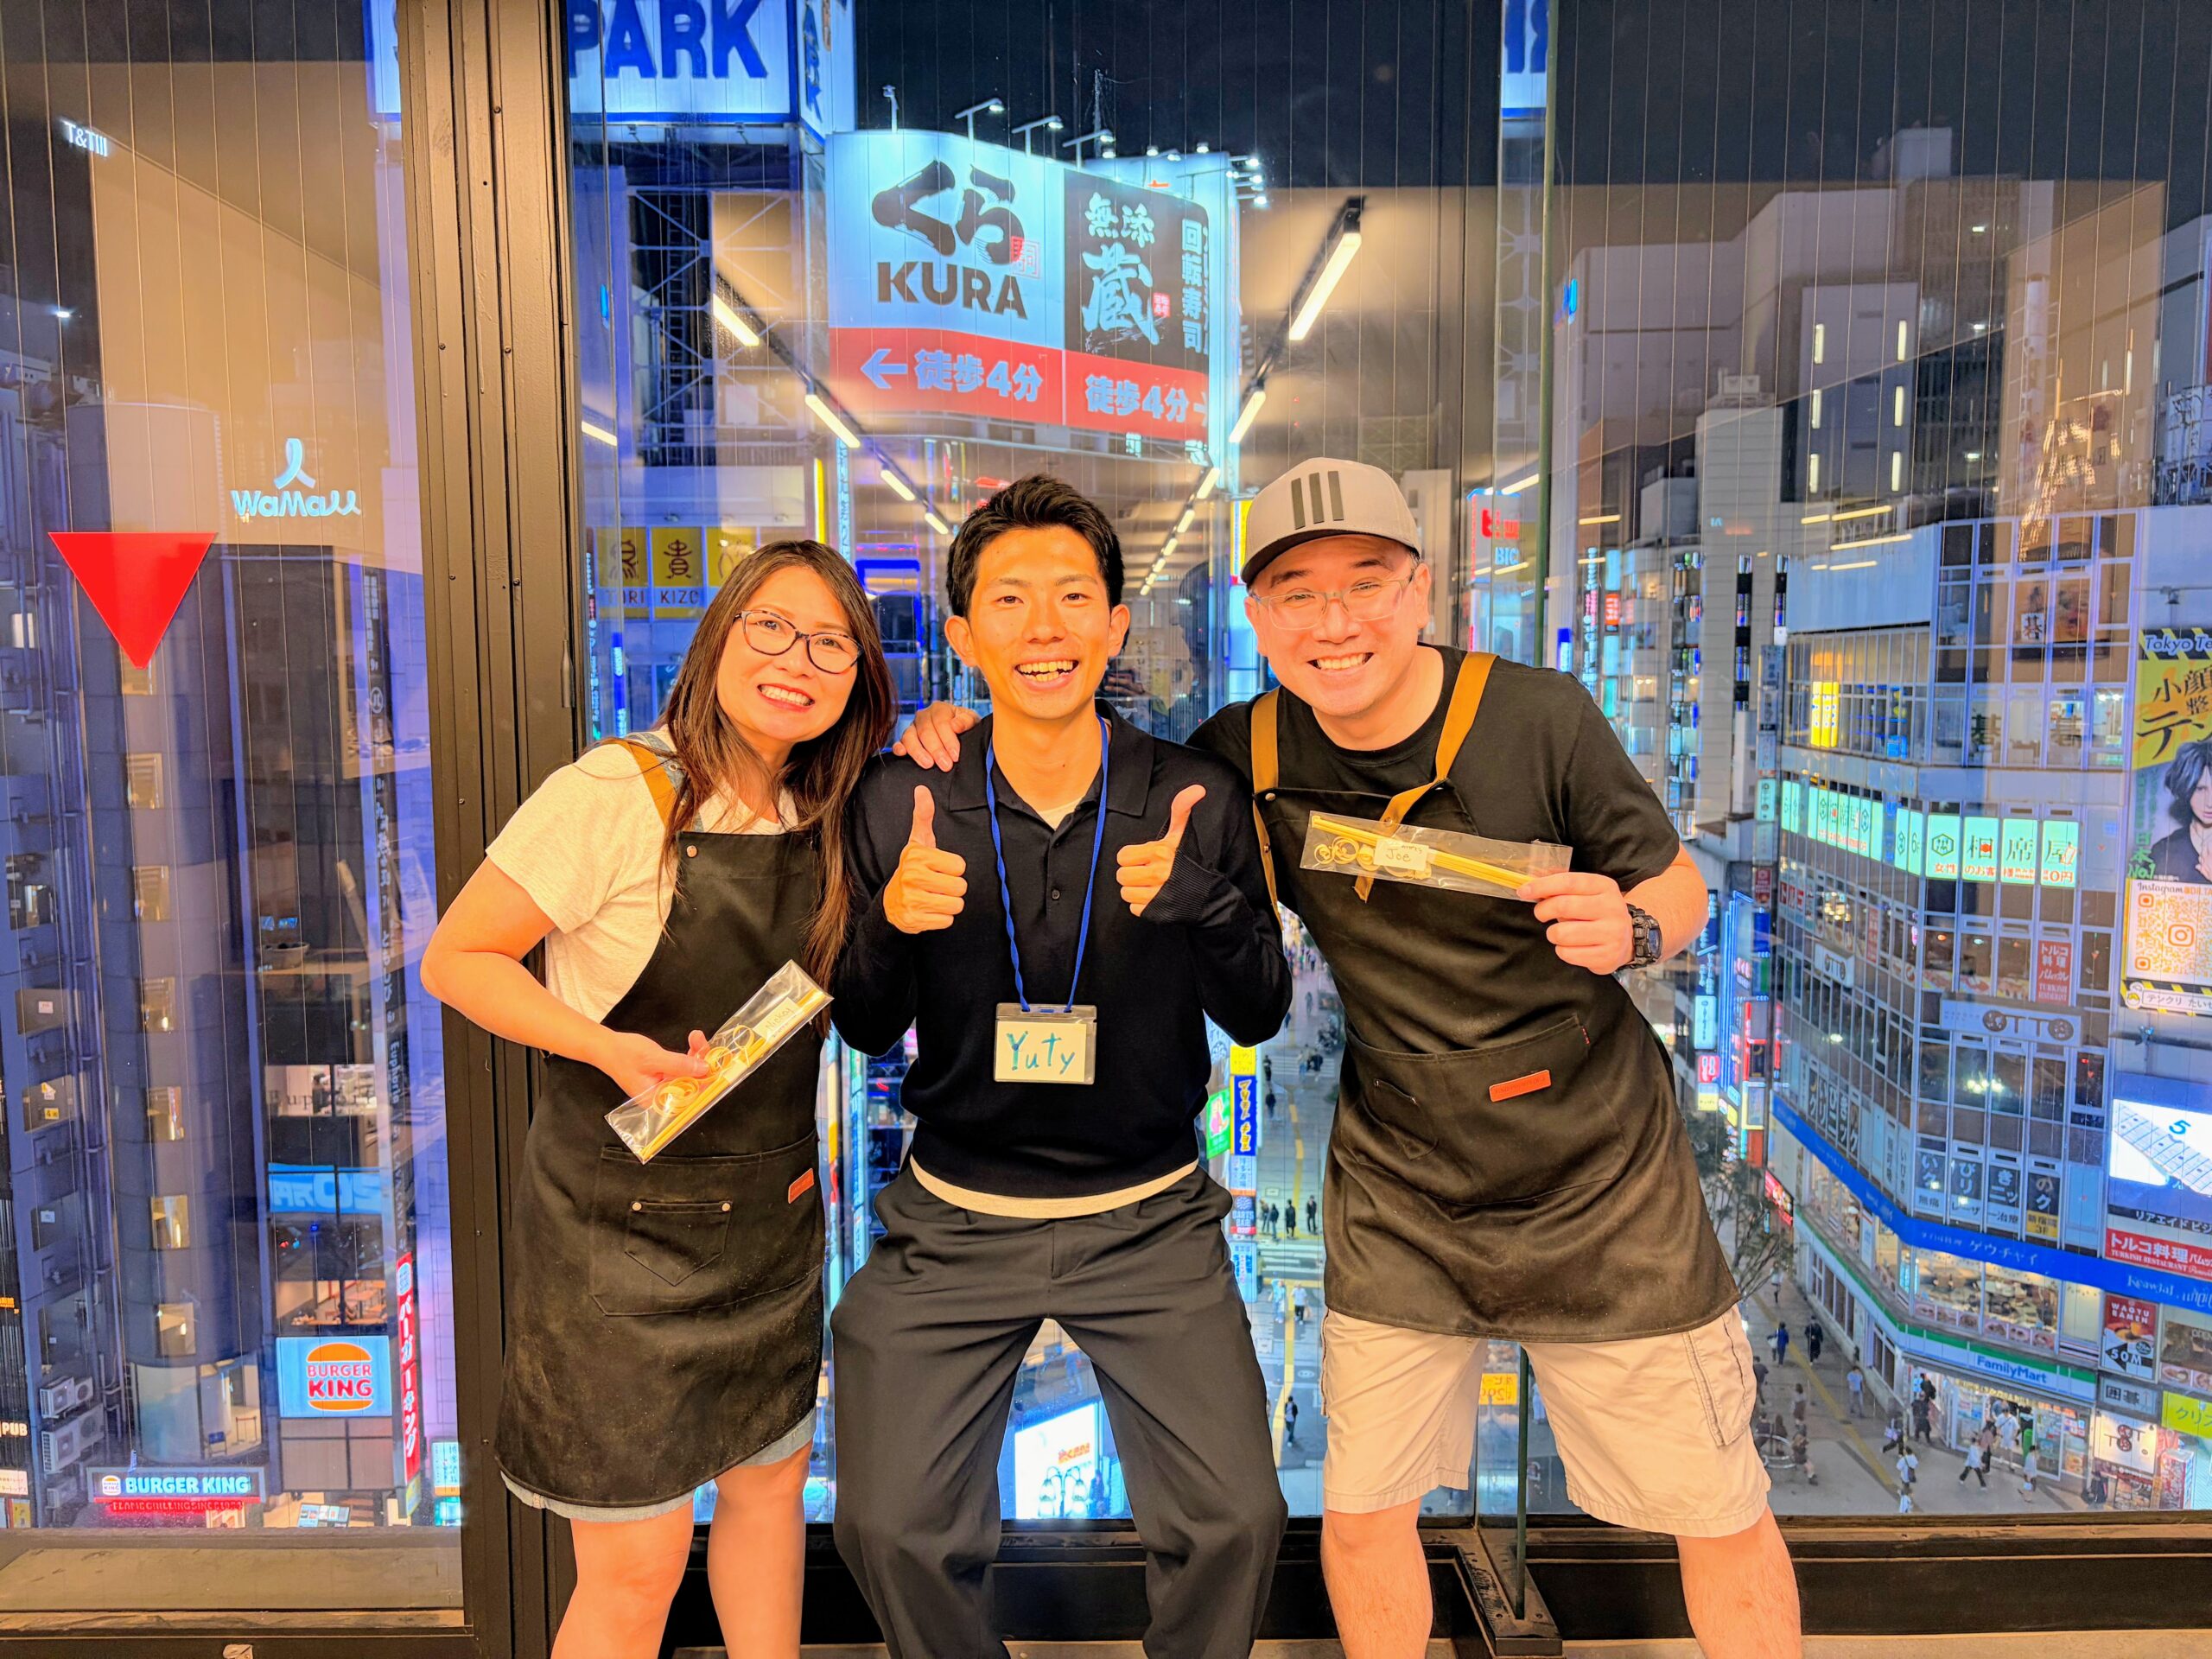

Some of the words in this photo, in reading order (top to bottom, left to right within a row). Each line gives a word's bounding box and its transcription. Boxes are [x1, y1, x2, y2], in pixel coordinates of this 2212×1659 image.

[568, 0, 767, 79] PARK
[871, 159, 1026, 265] くら
[877, 261, 1028, 320] KURA
[1181, 218, 1204, 354] 回転寿司
[914, 349, 1043, 402] 徒歩4分
[1084, 373, 1190, 423] 徒歩4分
[2145, 636, 2192, 655] Tokyo
[2131, 832, 2153, 863] 日本
[2127, 862, 2156, 880] No.1
[2137, 882, 2183, 897] Instagram
[1006, 1031, 1076, 1075] Yuty
[2111, 1233, 2189, 1264] トルコ料理
[2111, 1249, 2142, 1262] TURKISH
[2143, 1256, 2188, 1272] RESTAURANT
[2112, 1303, 2150, 1317] WAGYU
[2112, 1310, 2149, 1325] RAMEN
[307, 1363, 372, 1377] BURGER
[398, 1294, 418, 1459] バーガーキング
[1977, 1355, 2048, 1383] FamilyMart
[308, 1379, 373, 1398] KING
[3, 1423, 28, 1437] PUB
[125, 1476, 200, 1494] BURGER
[202, 1475, 251, 1494] KING
